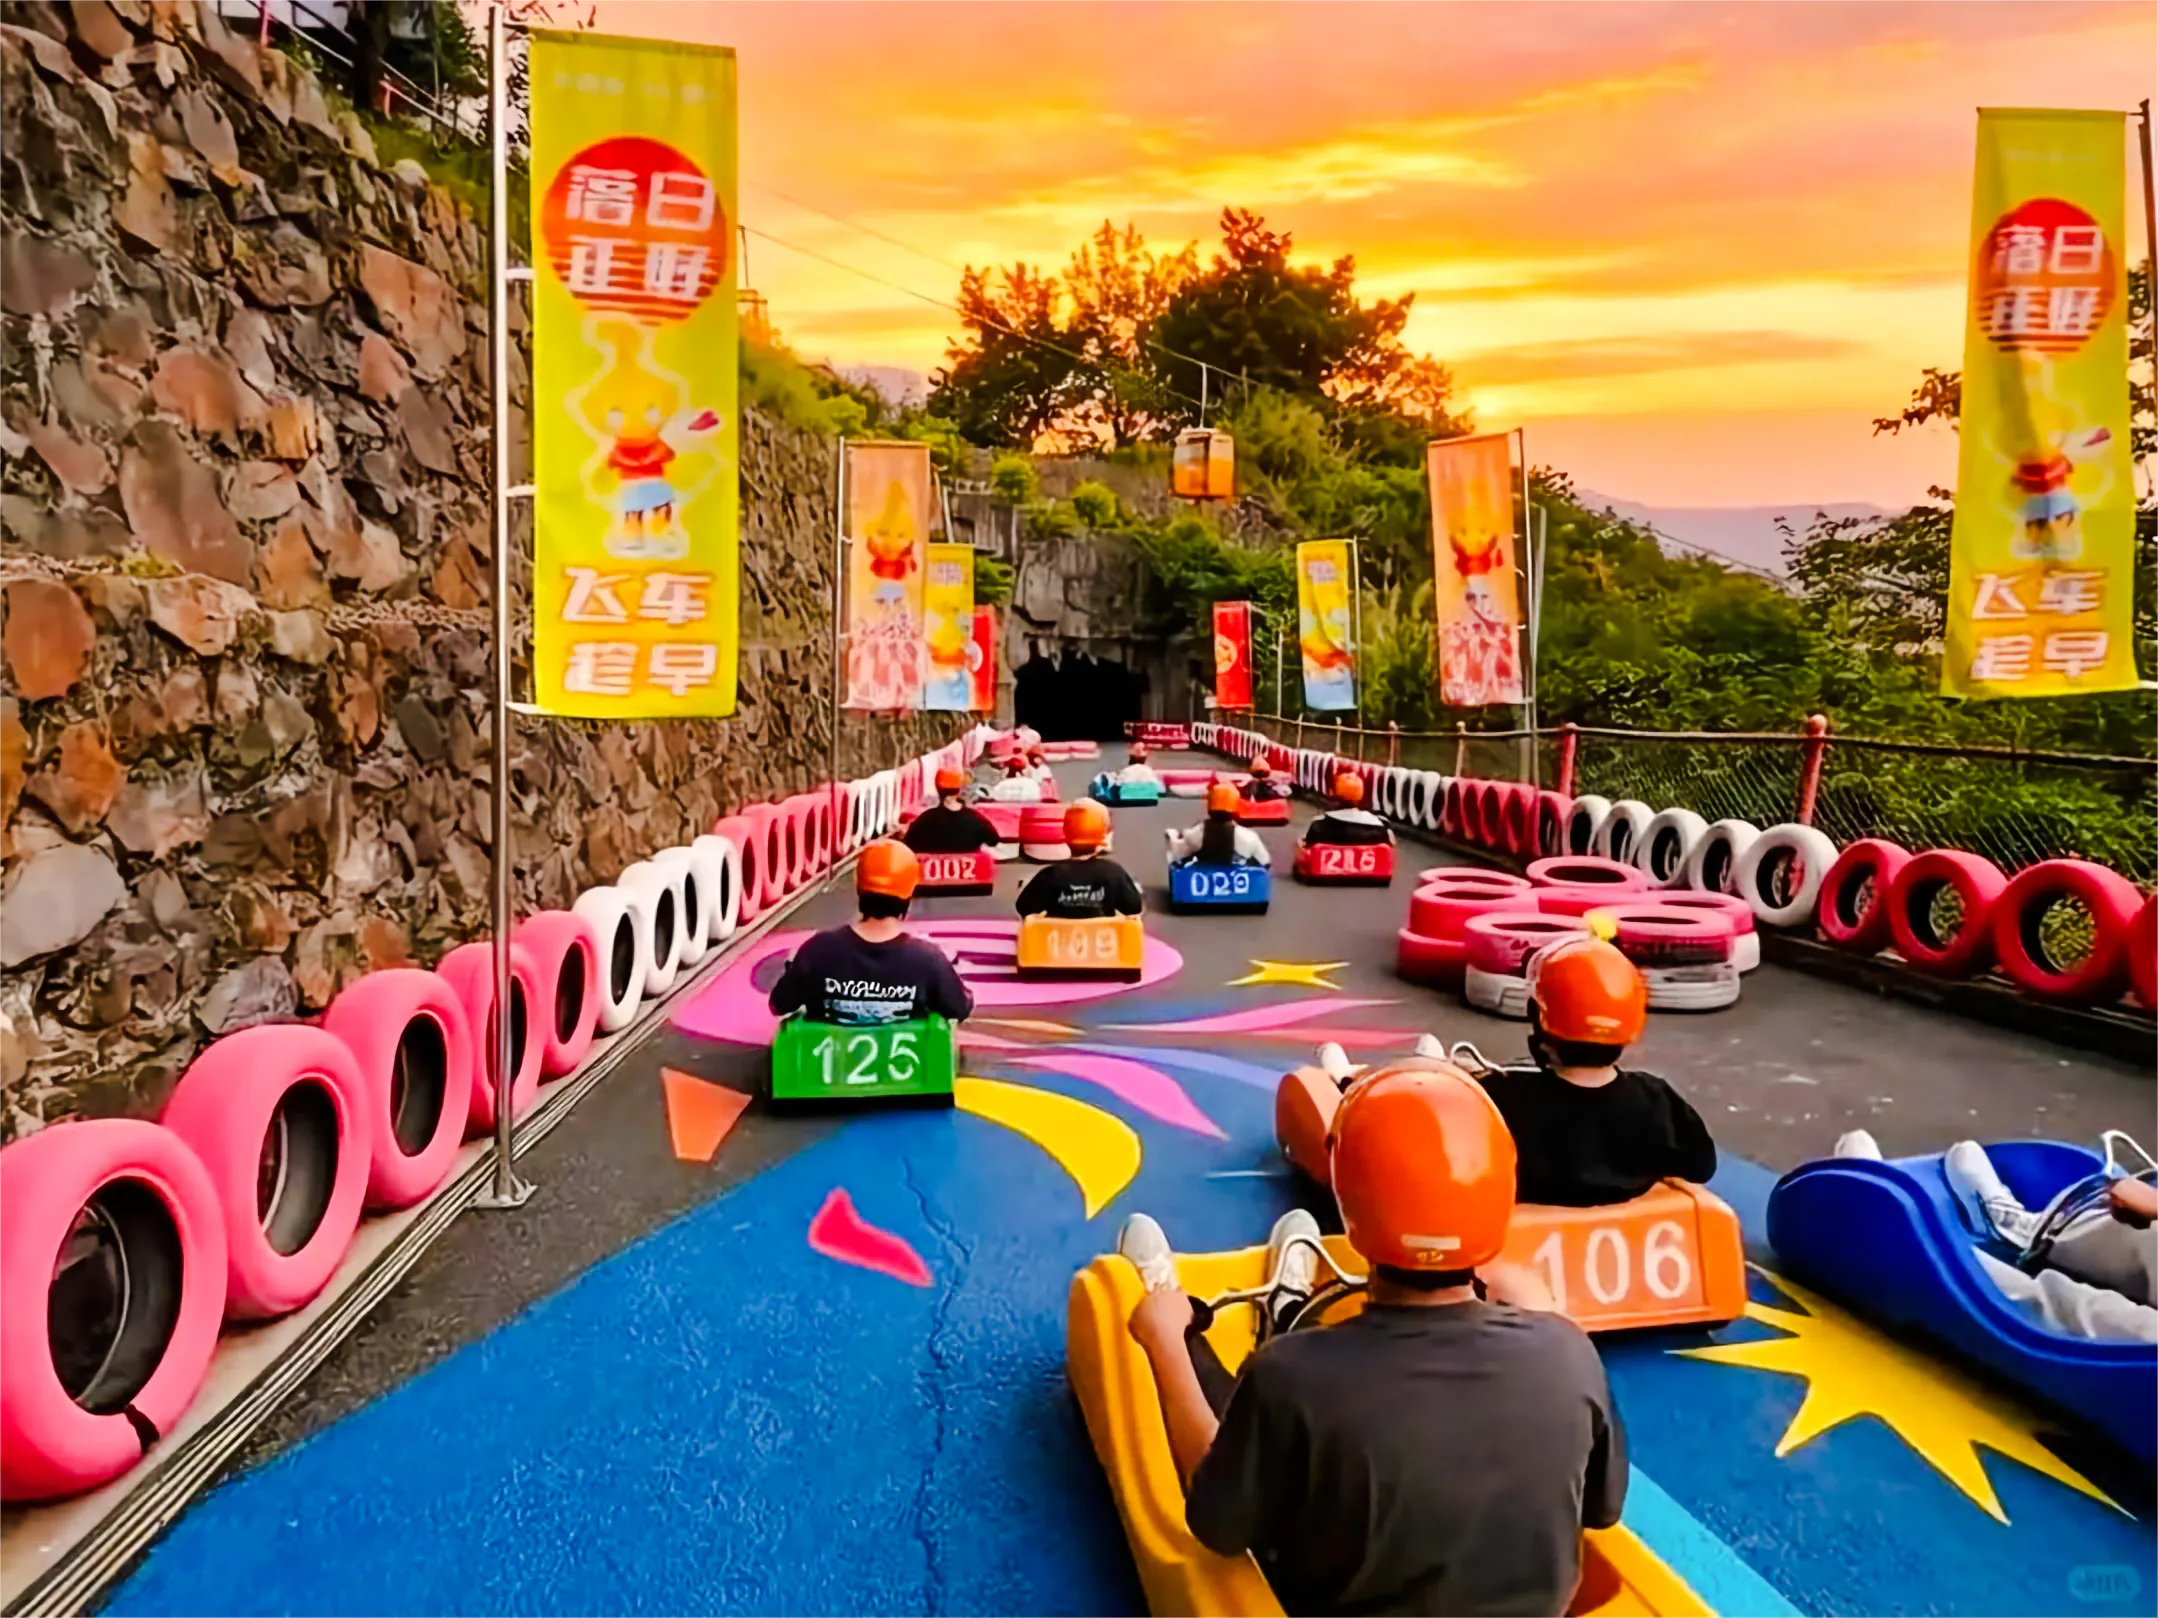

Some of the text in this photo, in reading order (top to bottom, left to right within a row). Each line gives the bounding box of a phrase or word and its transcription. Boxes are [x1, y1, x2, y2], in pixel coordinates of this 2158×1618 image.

[565, 164, 715, 232] 落日
[562, 566, 712, 625] 飞车
[1971, 570, 2105, 619] 飞车
[812, 1032, 920, 1085] 125
[1533, 1220, 1692, 1312] 106
